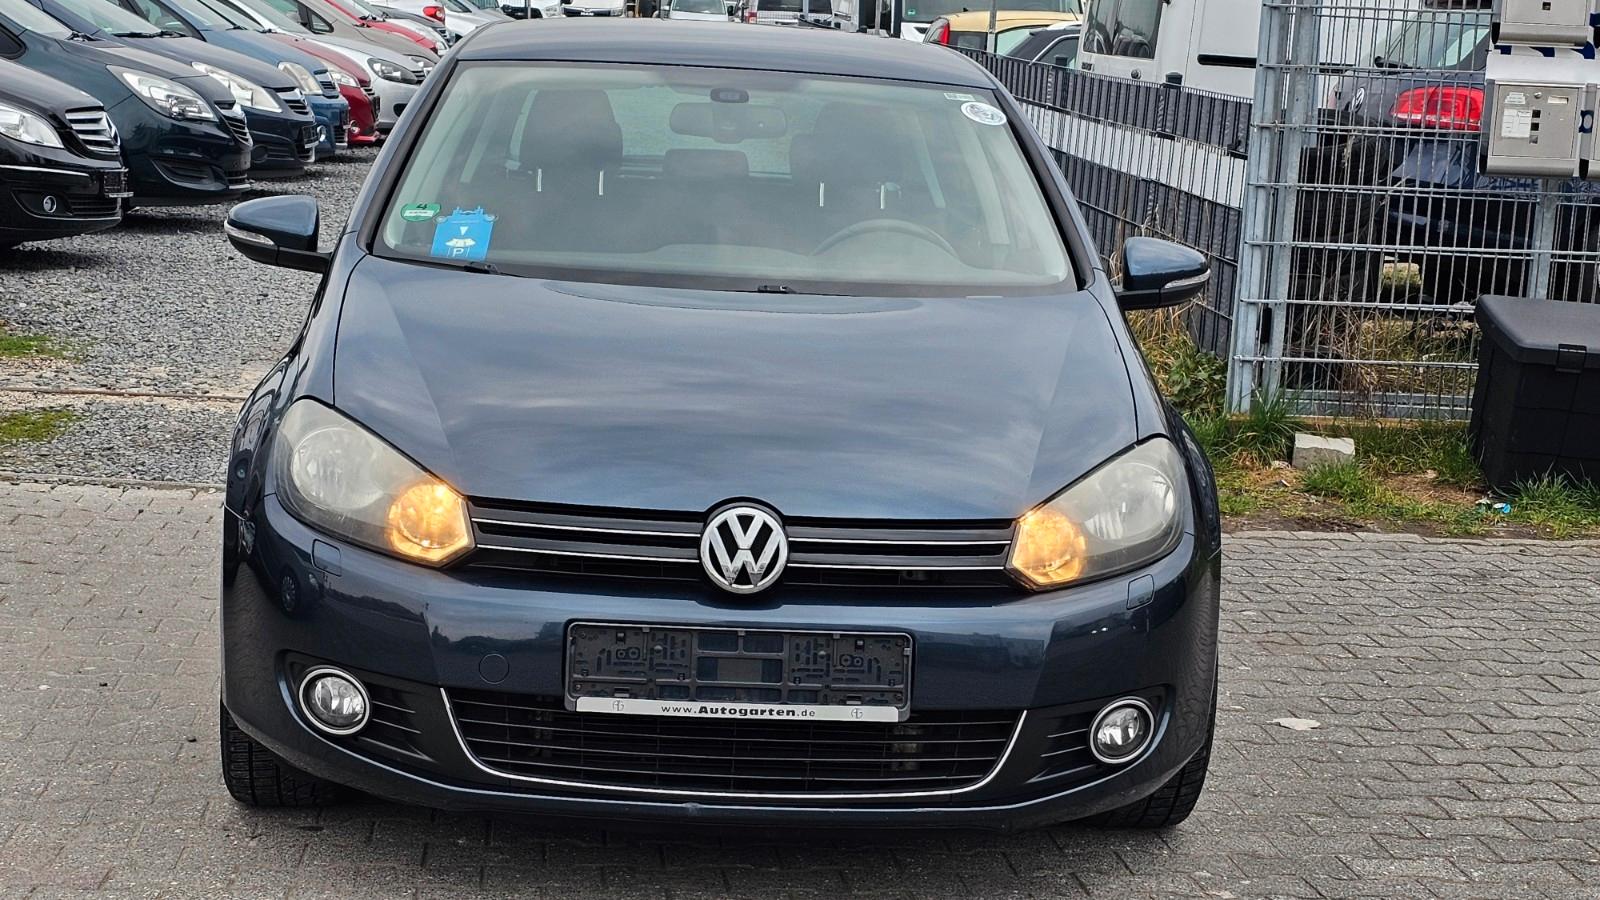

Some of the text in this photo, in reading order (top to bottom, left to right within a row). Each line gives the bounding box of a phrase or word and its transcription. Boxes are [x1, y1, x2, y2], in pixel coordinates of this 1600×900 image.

[452, 247, 464, 257] P
[702, 508, 786, 592] VW
[661, 705, 816, 718] www.Autogarten.de
